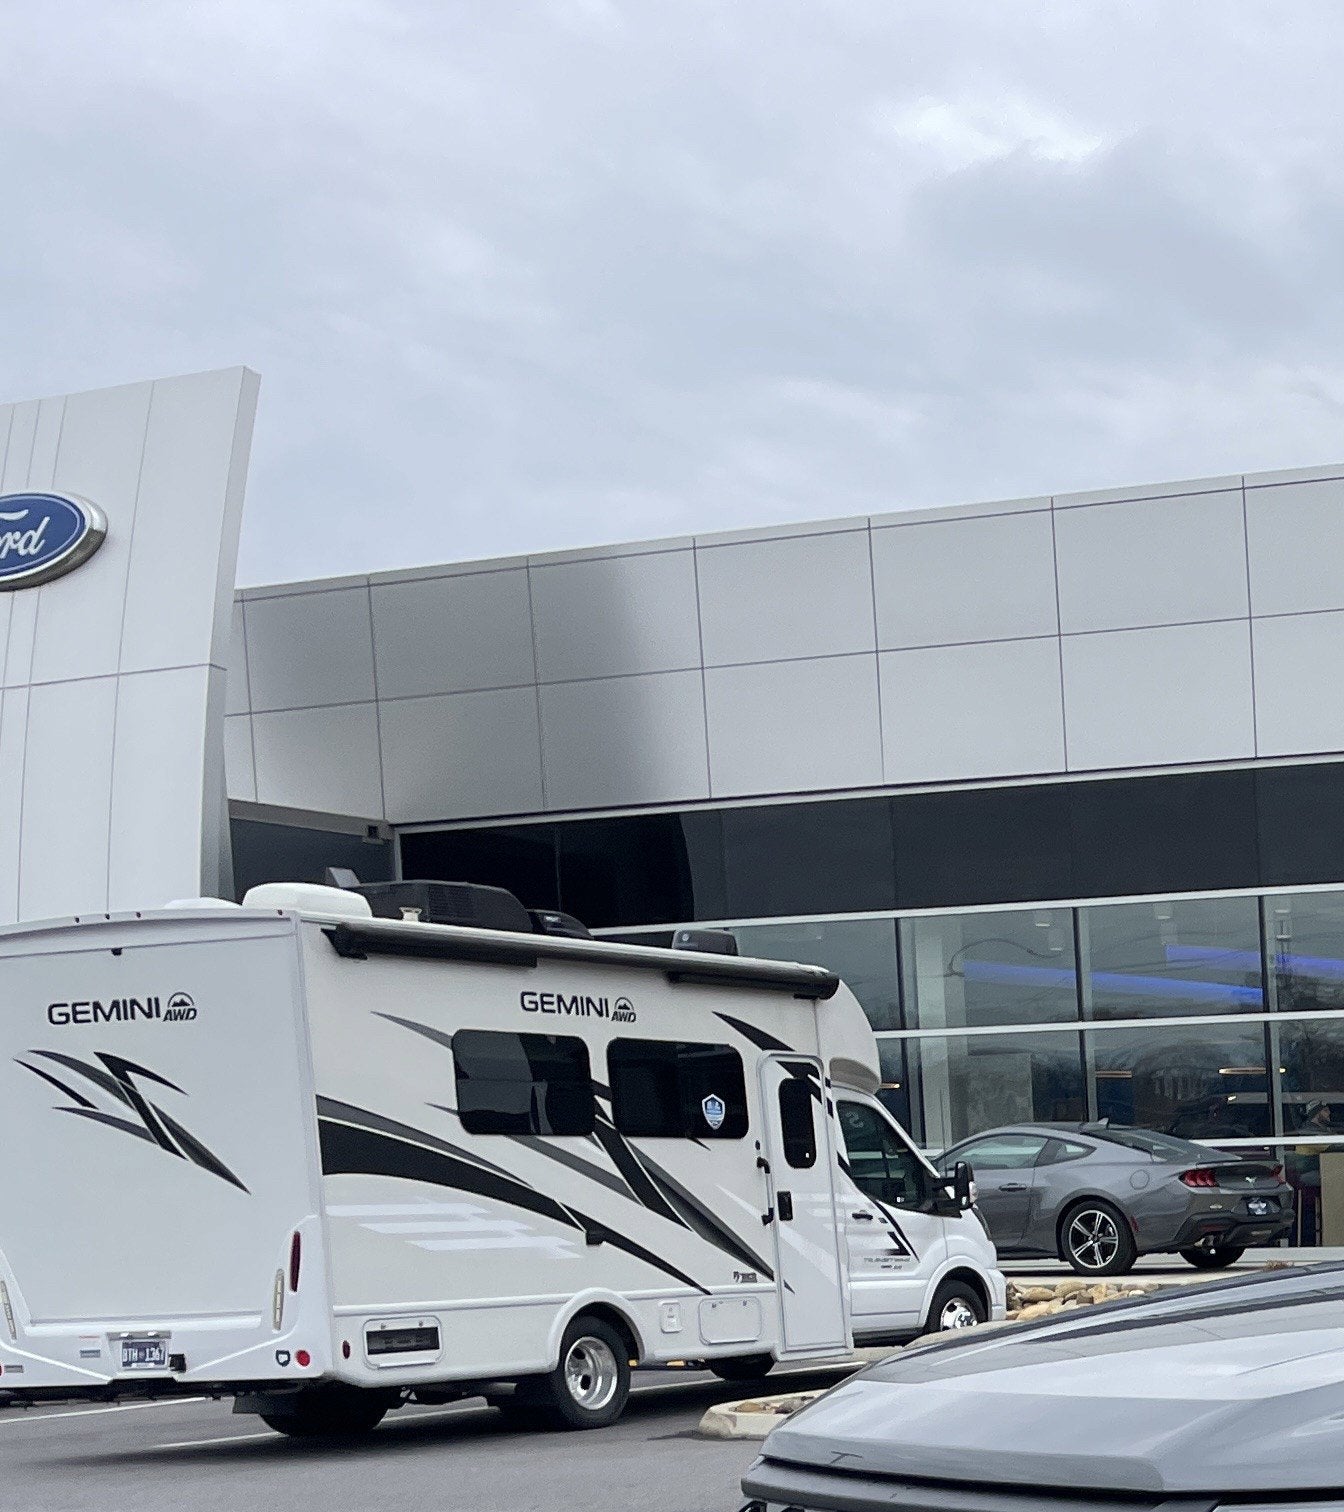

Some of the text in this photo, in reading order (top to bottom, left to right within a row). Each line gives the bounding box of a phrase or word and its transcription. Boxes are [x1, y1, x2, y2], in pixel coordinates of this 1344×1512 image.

[47, 997, 197, 1026] GEMINI AWD
[520, 991, 637, 1023] GEMINI AWD
